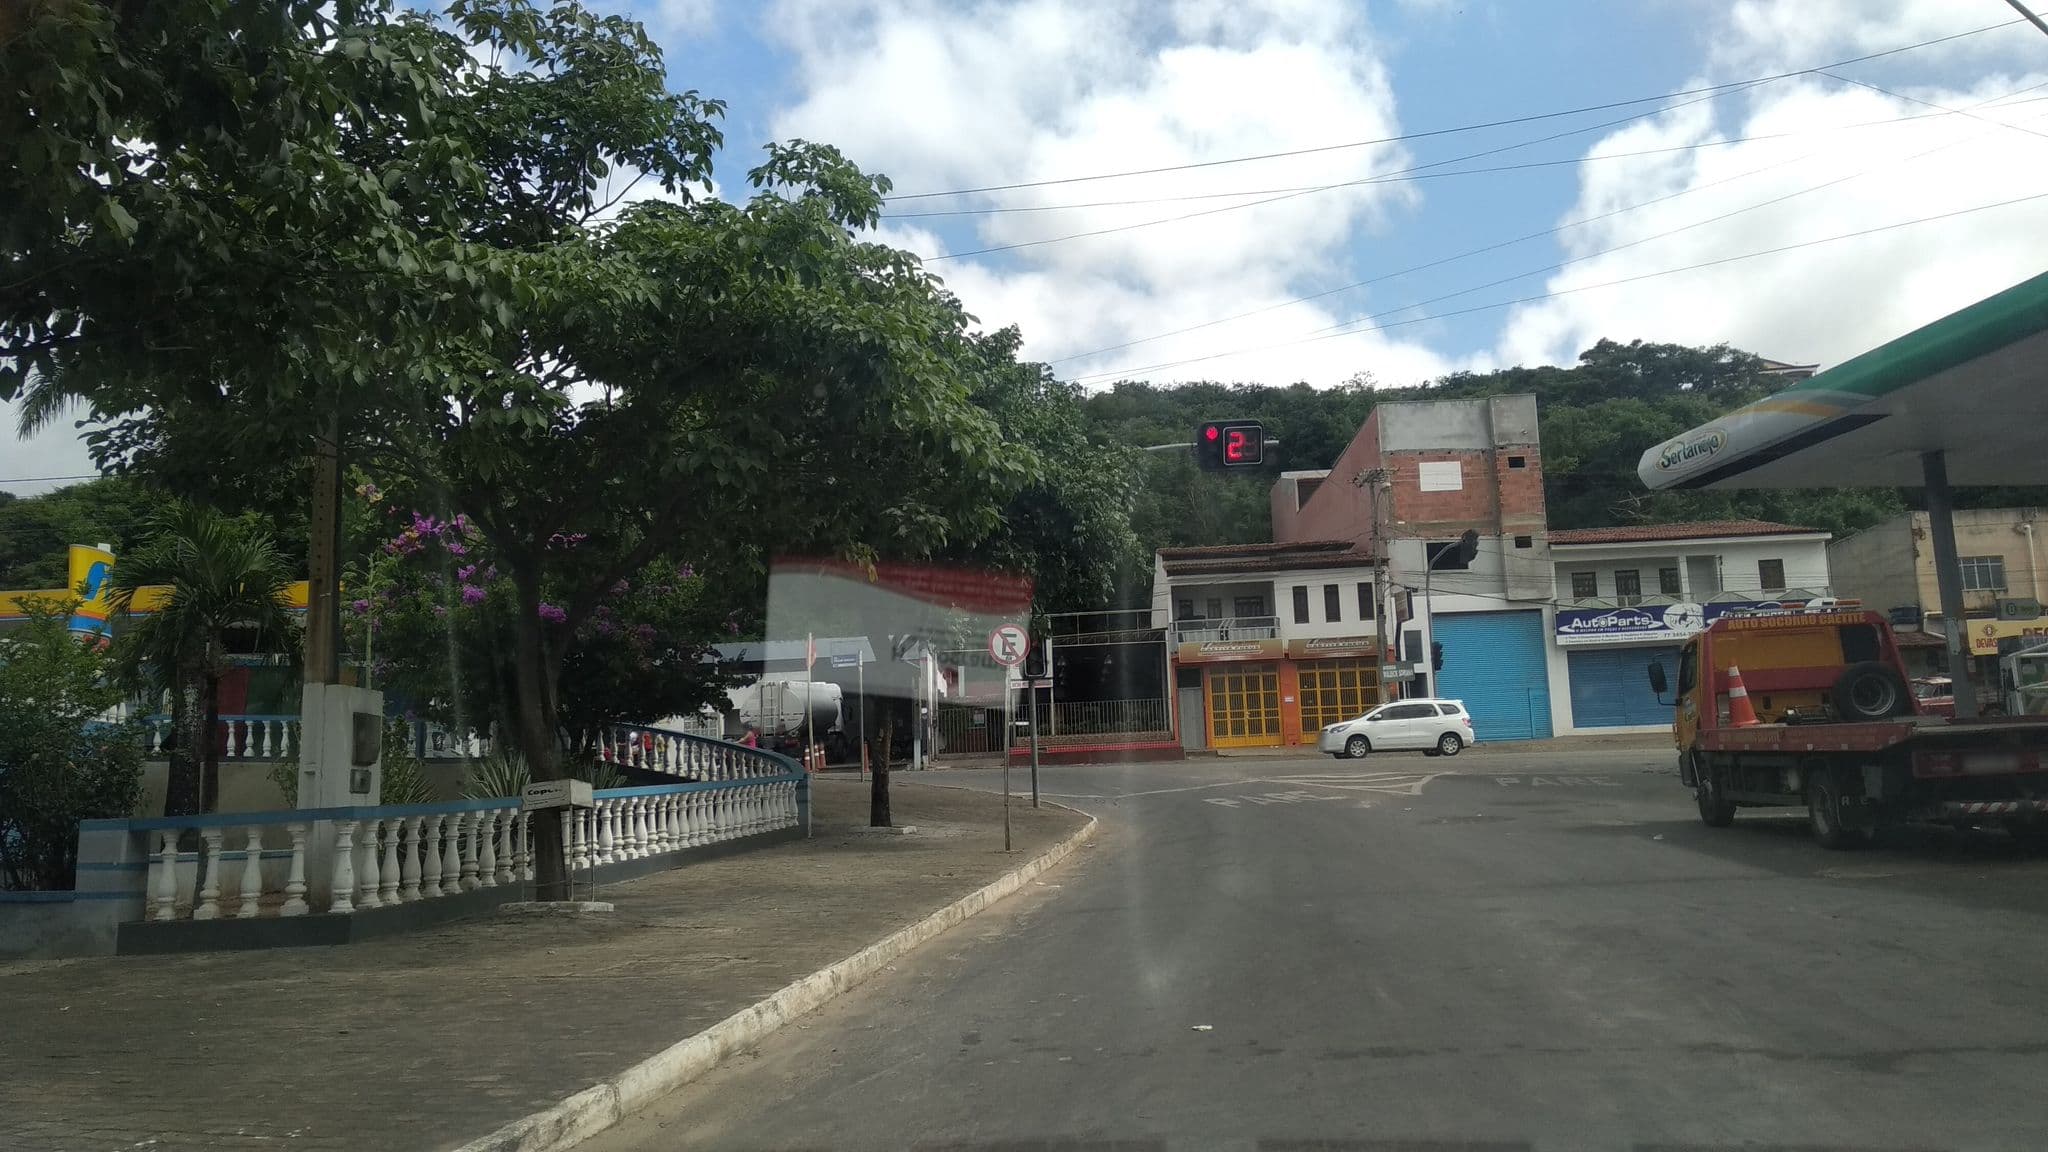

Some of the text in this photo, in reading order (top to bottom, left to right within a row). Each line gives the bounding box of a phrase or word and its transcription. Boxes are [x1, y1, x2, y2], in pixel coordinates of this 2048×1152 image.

[1228, 432, 1246, 460] 2
[1661, 435, 1719, 468] Sertanejo
[1727, 618, 1757, 630] AUTO
[1760, 615, 1817, 628] SOCORRO
[1976, 638, 1998, 649] DEVAS
